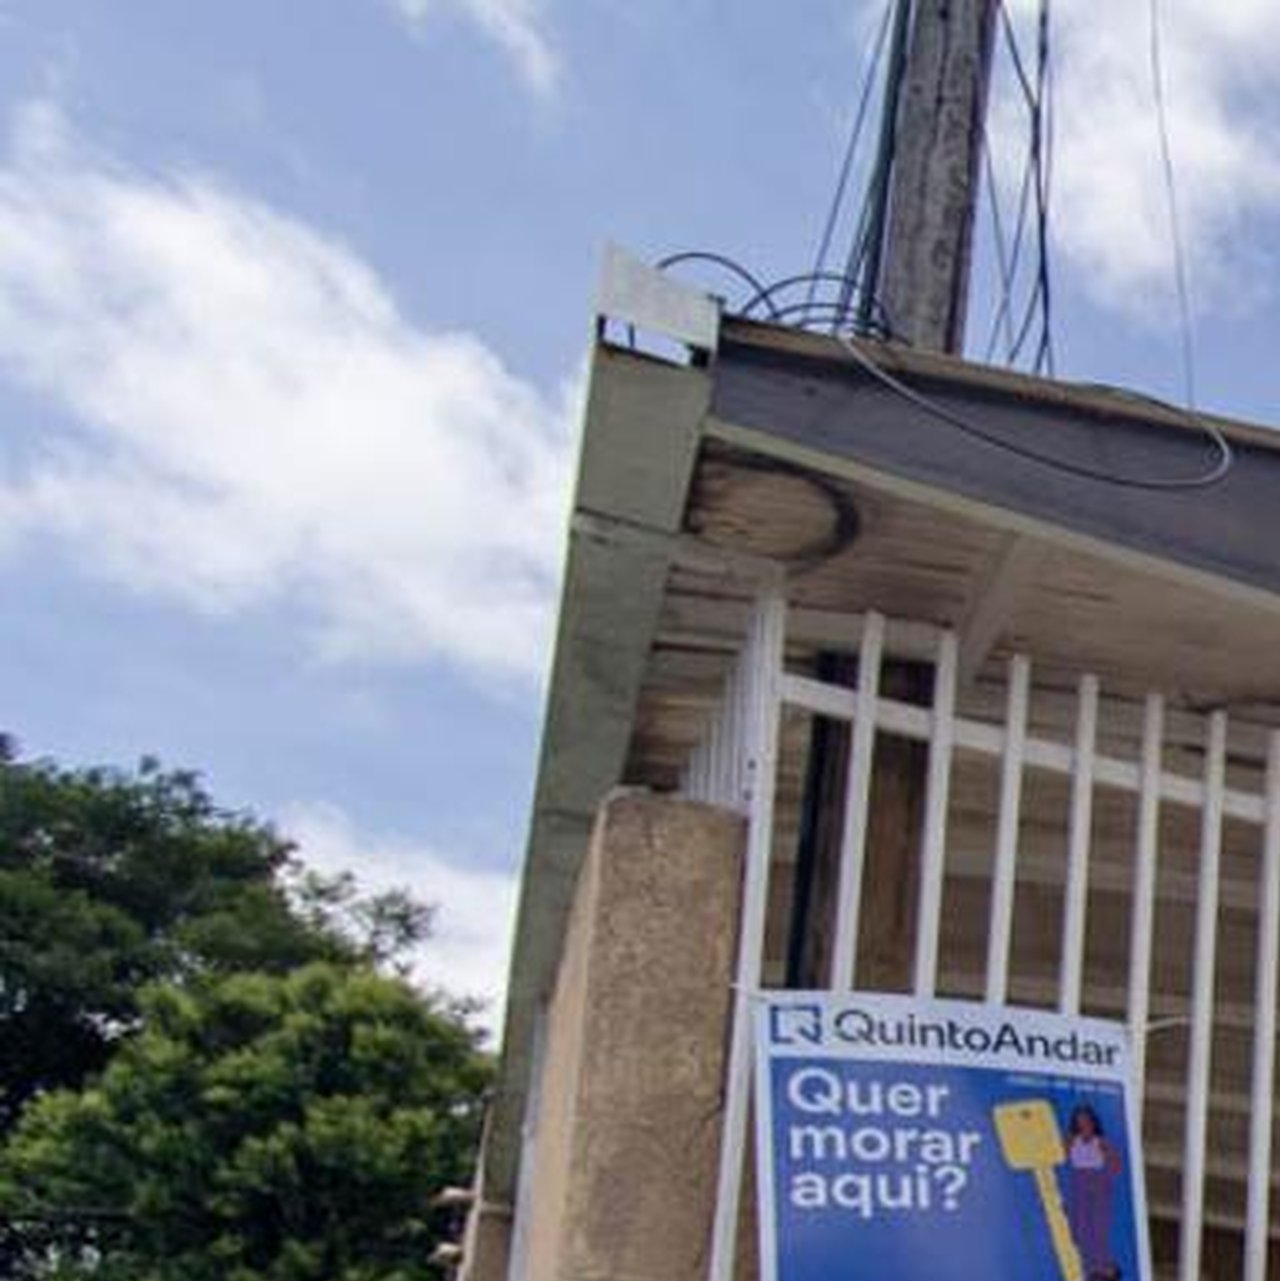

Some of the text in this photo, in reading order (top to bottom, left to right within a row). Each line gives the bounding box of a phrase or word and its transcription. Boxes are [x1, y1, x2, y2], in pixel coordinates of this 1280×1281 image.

[833, 1007, 1120, 1066] QuintoAndar
[787, 1066, 950, 1117] Quer
[789, 1123, 982, 1165] morar
[790, 1164, 968, 1219] aqui?
